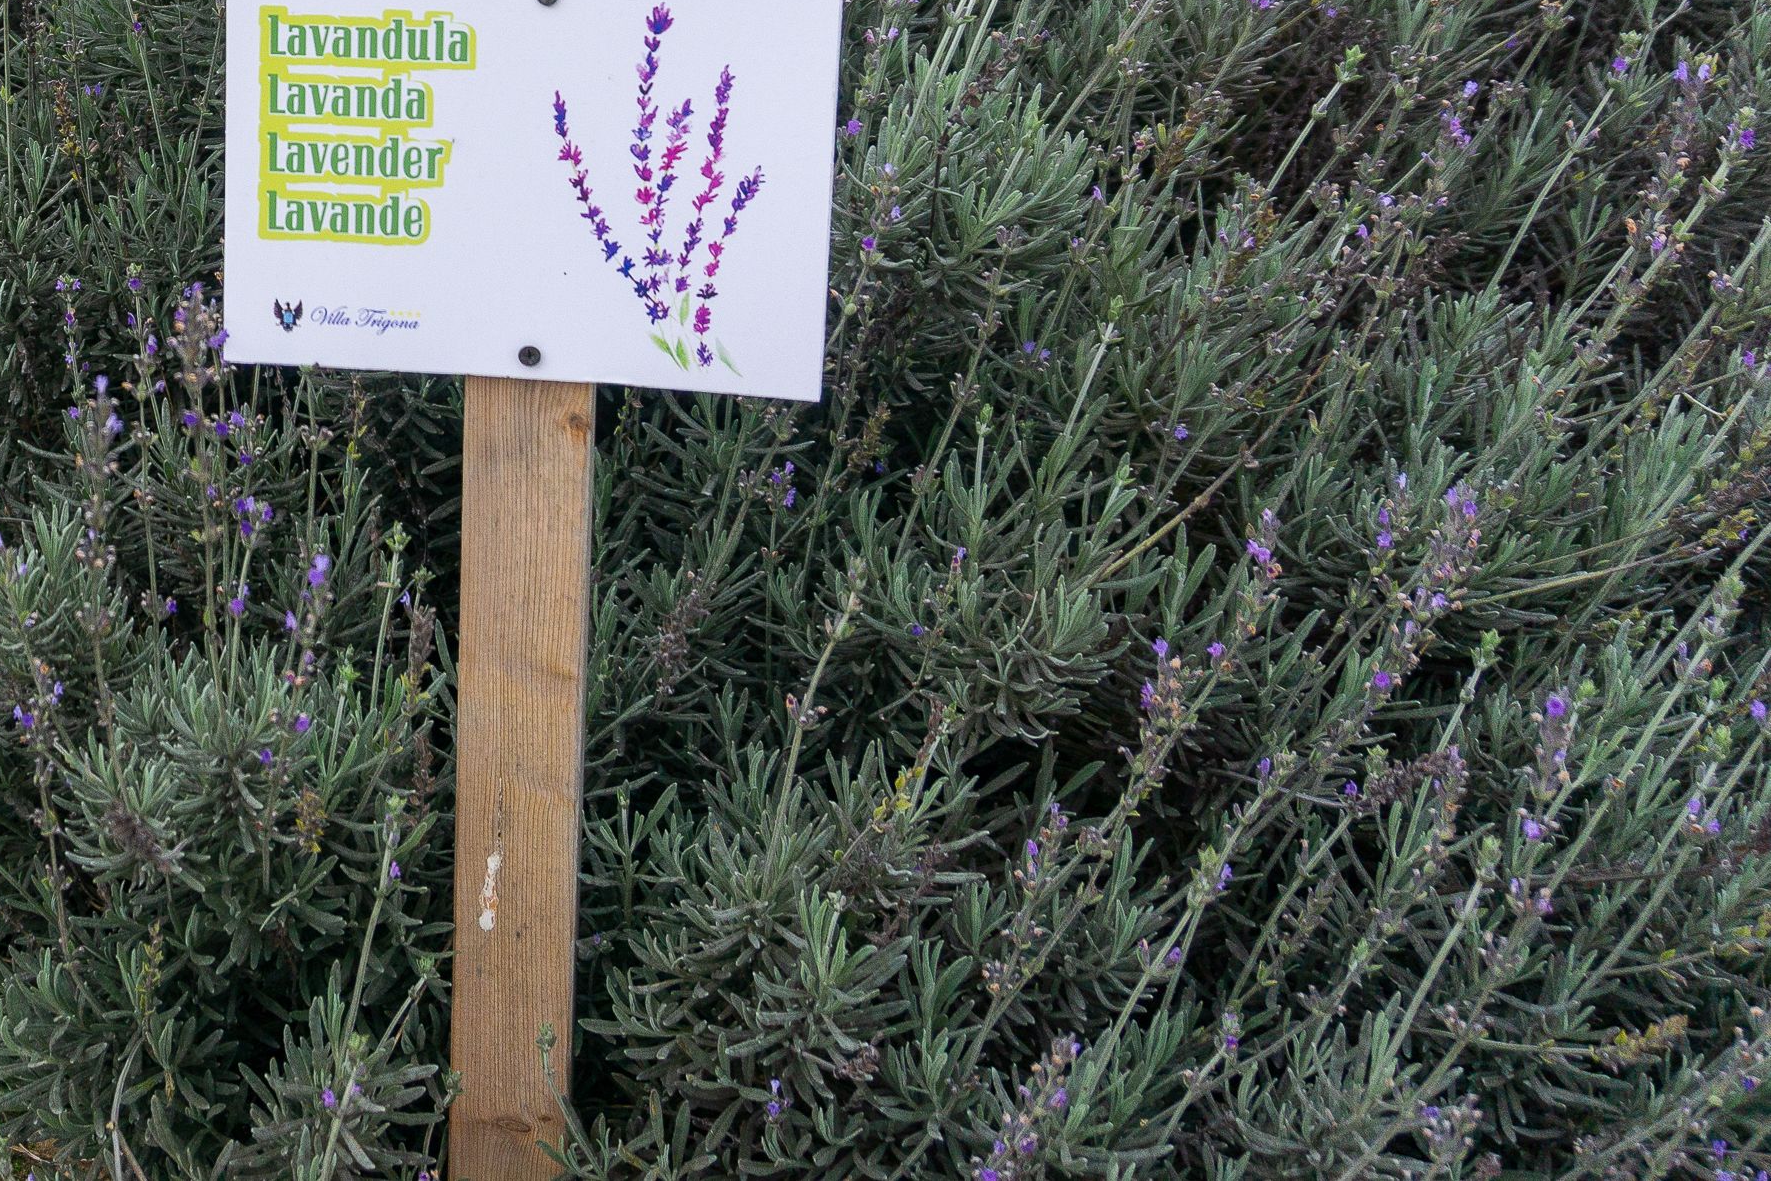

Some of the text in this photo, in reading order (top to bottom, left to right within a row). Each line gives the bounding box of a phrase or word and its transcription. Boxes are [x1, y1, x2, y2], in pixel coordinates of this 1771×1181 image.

[268, 14, 469, 62] Lavandula
[267, 73, 426, 120] Lavanda
[267, 131, 445, 180] Lavender
[266, 189, 424, 238] Lavande
[310, 305, 421, 336] Villa Trigona
